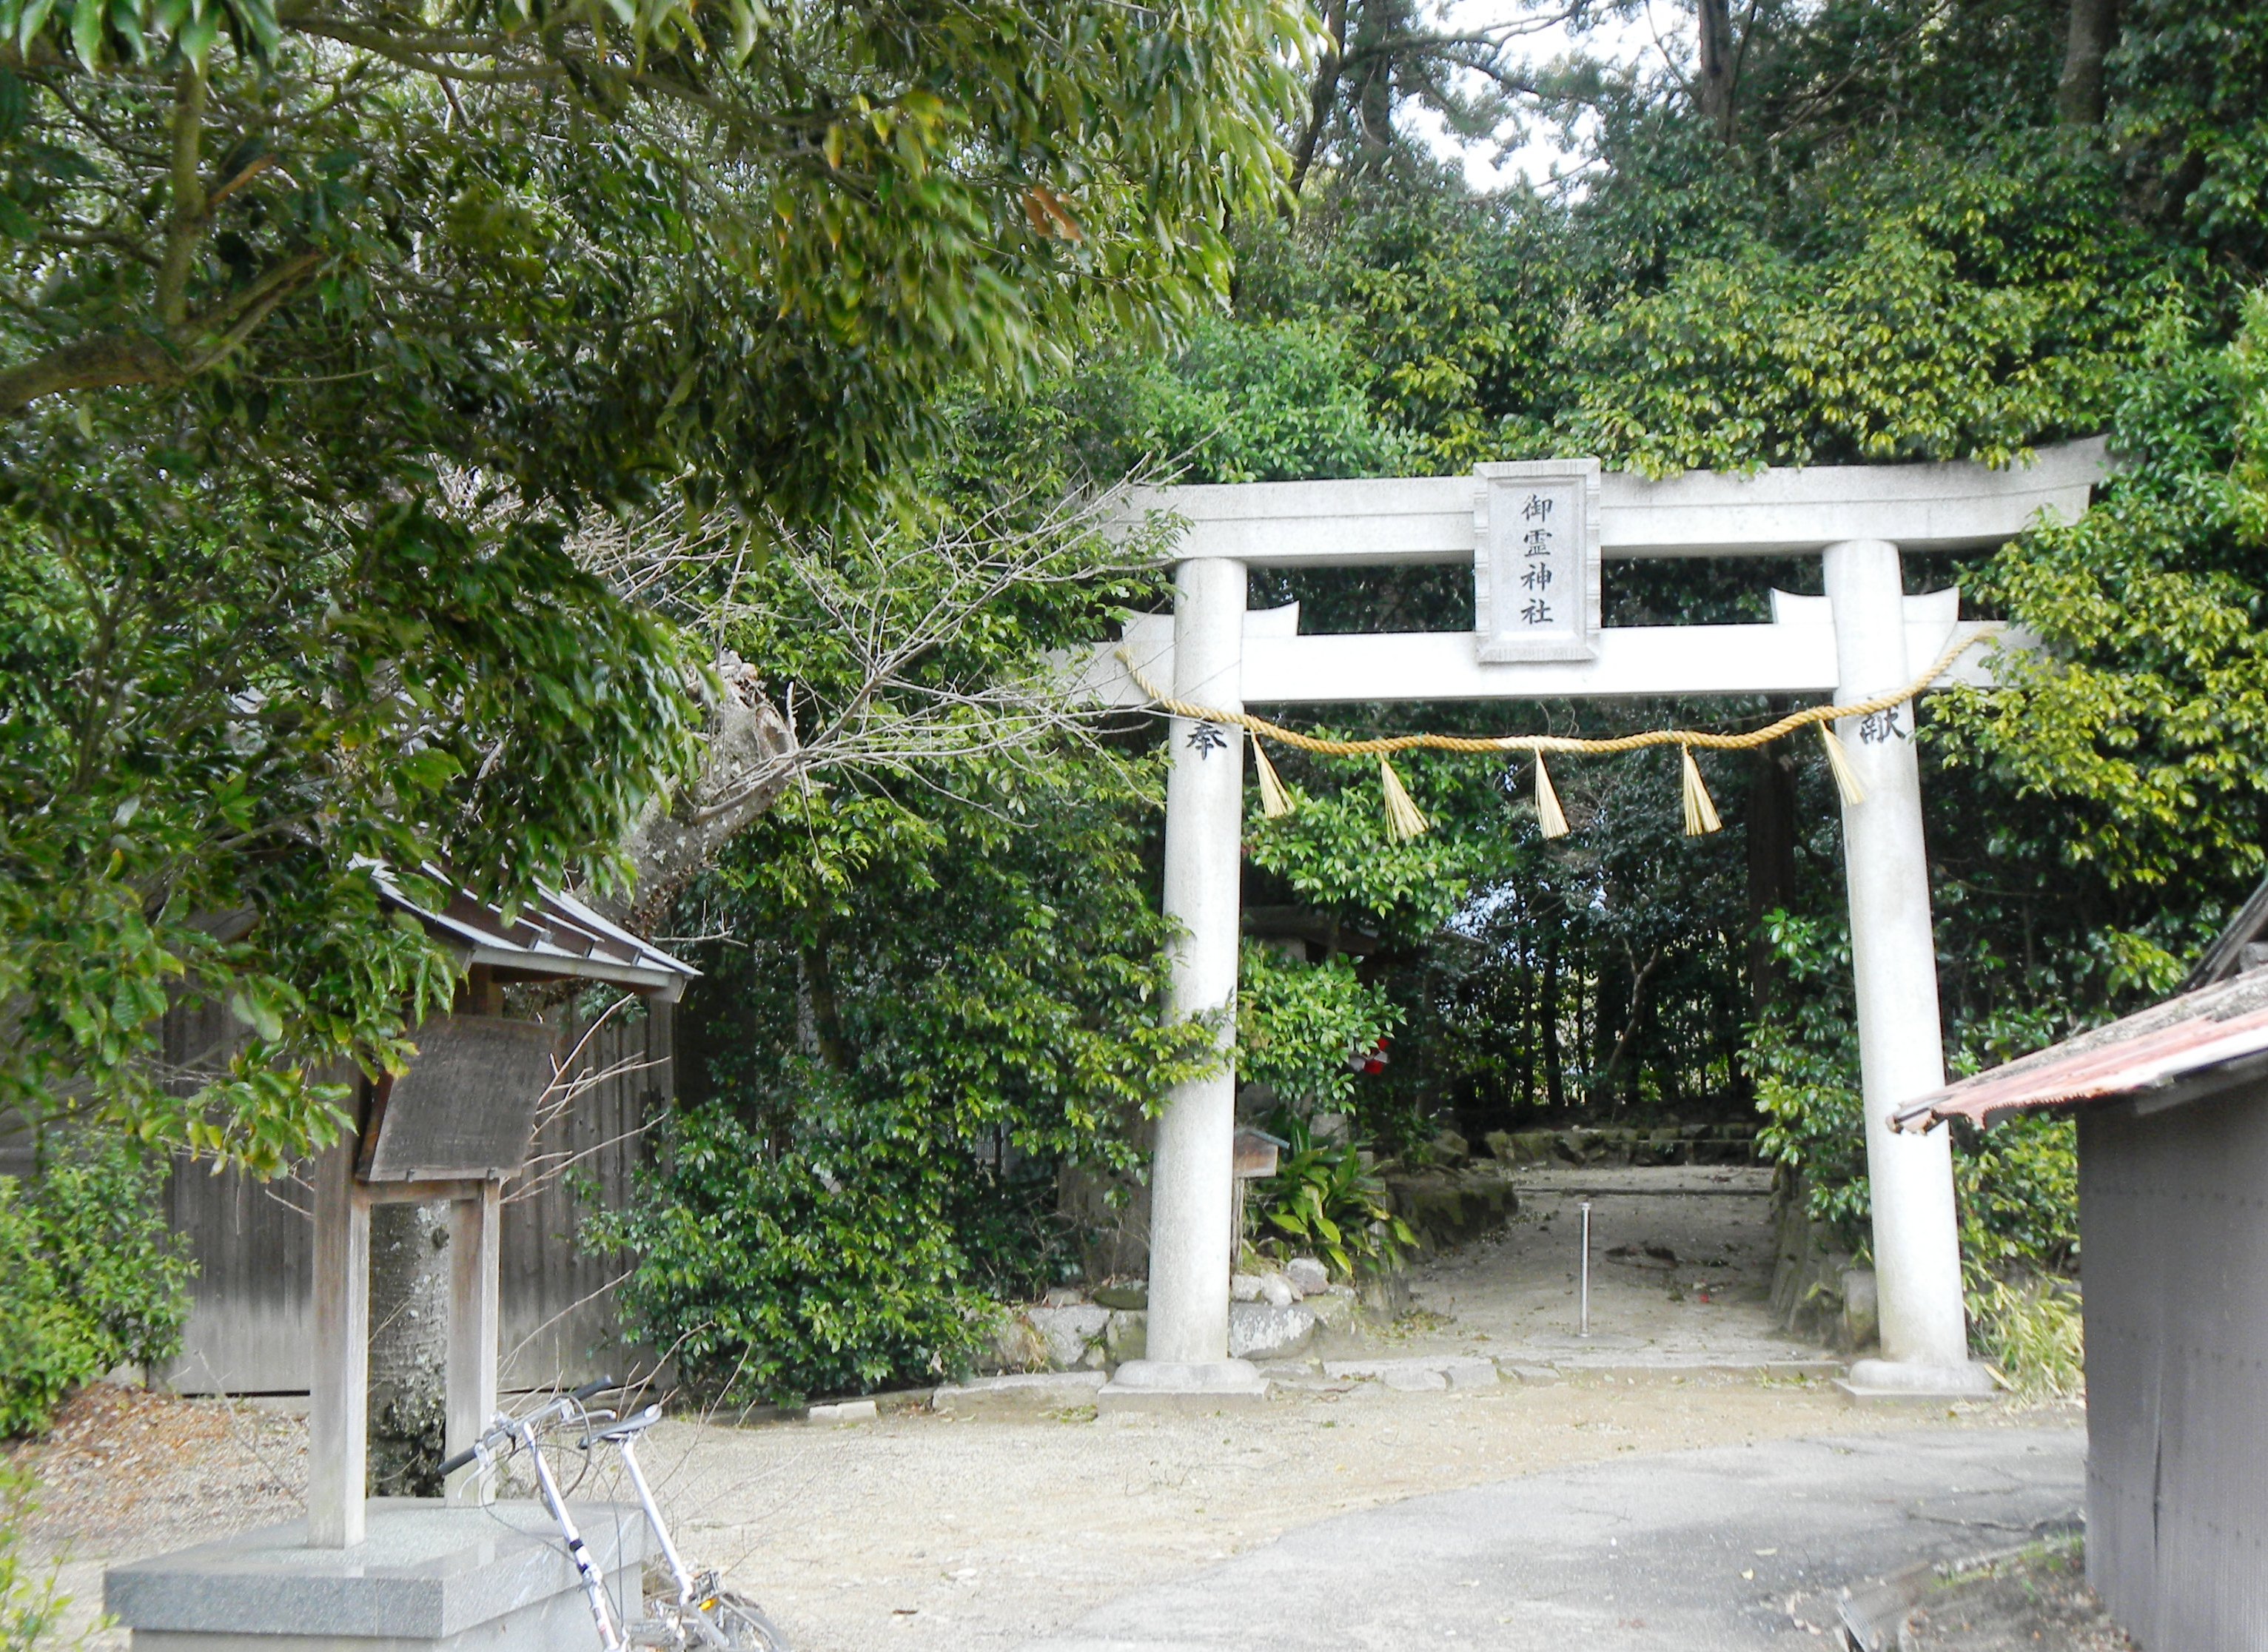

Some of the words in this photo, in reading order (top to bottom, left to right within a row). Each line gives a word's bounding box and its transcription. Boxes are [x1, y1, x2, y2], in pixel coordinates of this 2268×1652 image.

[1520, 493, 1554, 625] 御霊神社
[1186, 722, 1227, 760] 奉
